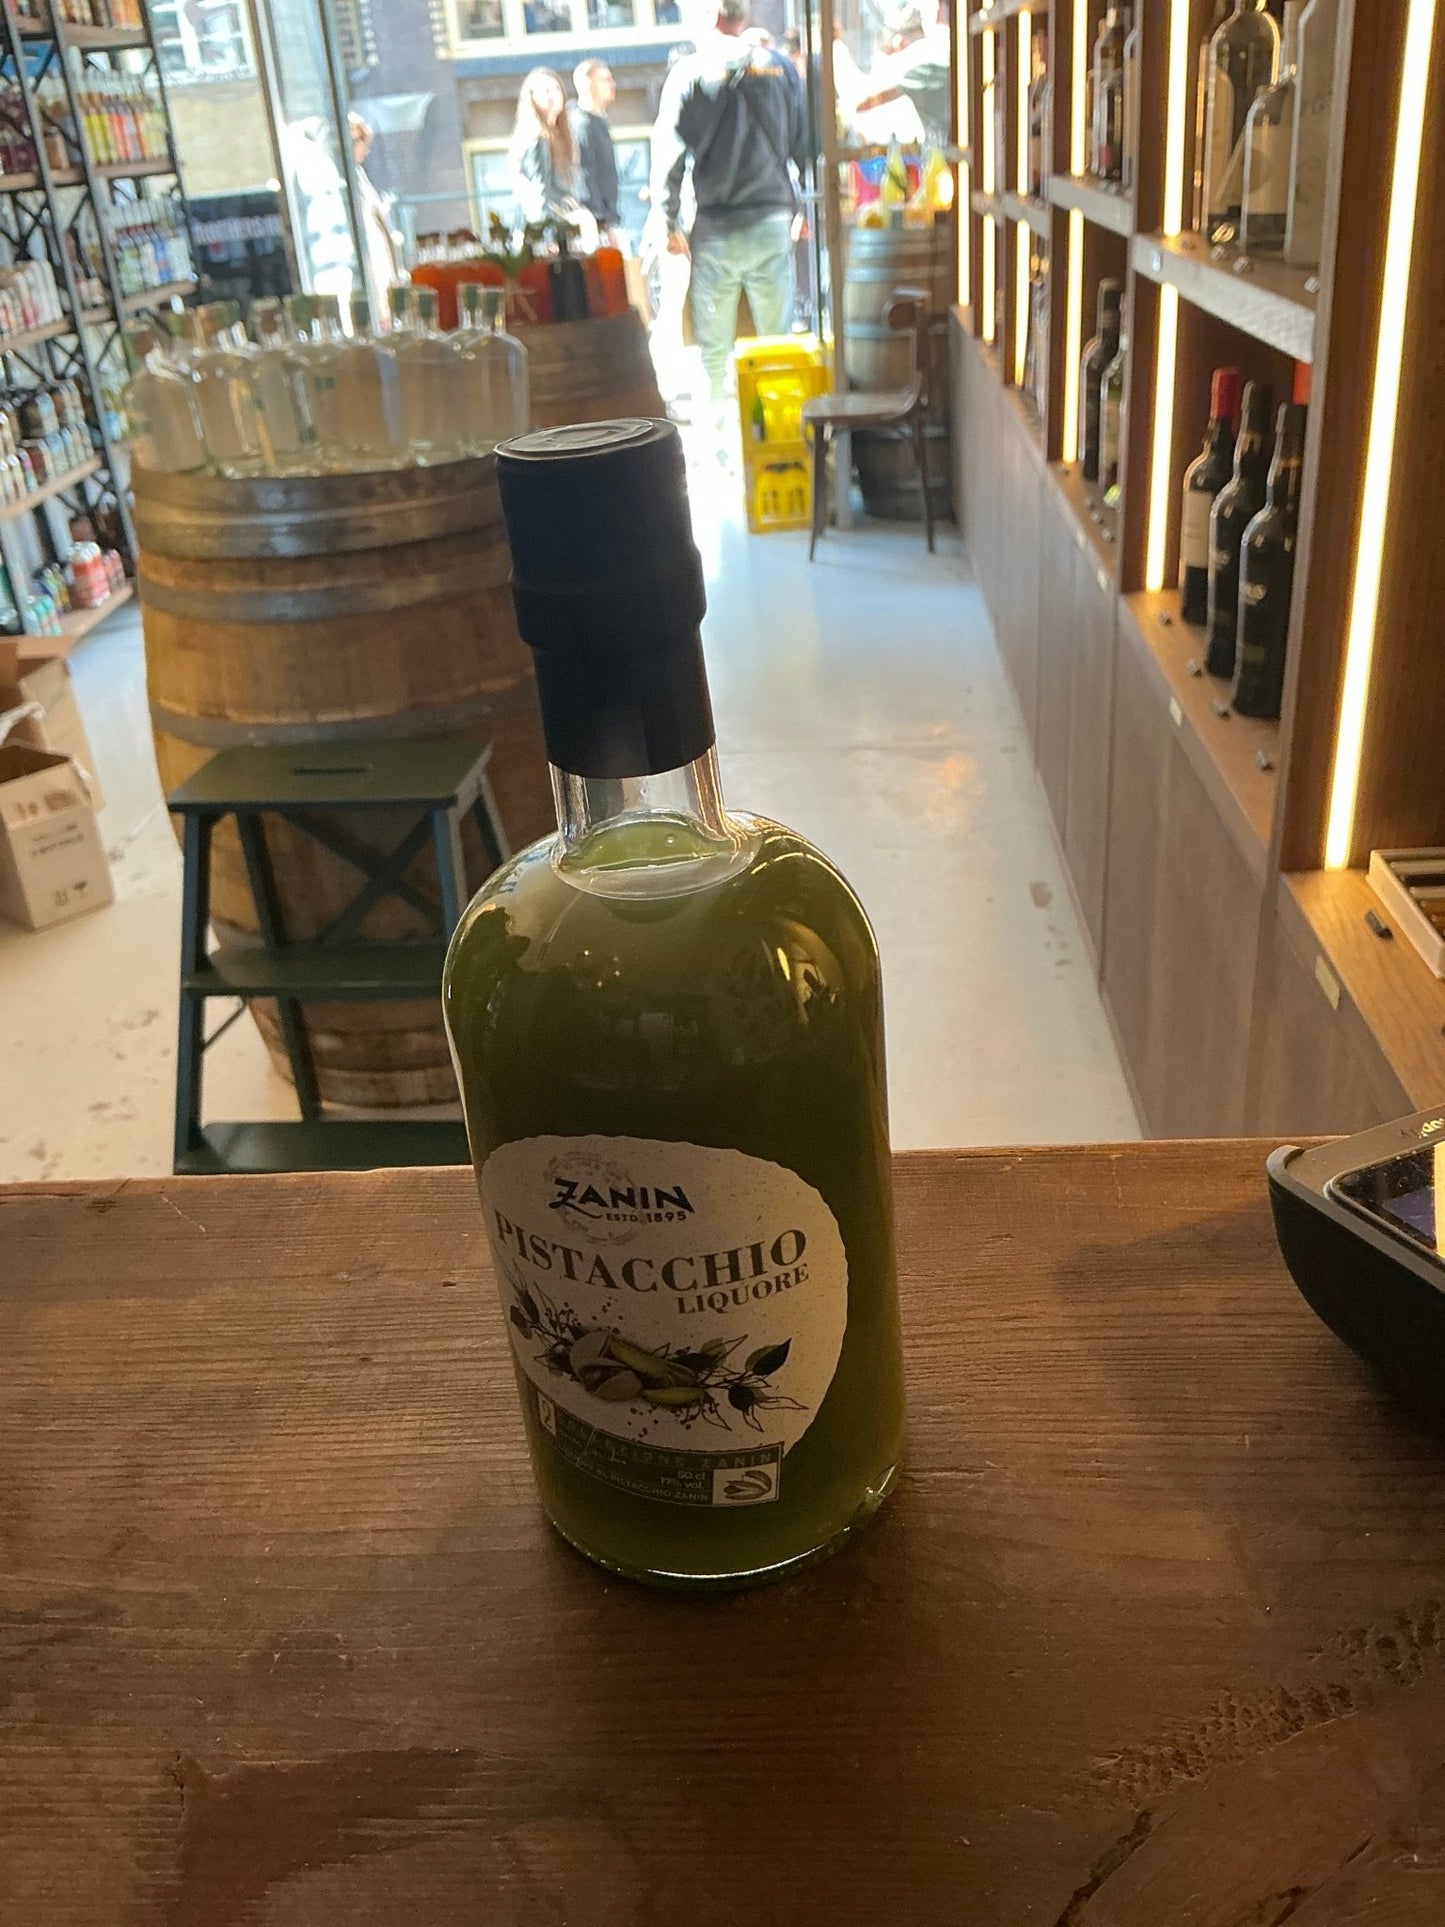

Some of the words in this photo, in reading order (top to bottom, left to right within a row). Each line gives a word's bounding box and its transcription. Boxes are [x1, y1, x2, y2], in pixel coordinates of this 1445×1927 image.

[548, 1177, 695, 1218] ZANIN
[646, 1210, 688, 1223] 1895
[494, 1208, 808, 1293] PISTACCHIO
[676, 1263, 810, 1315] LIQUORE
[673, 1491, 709, 1502] ZANIN
